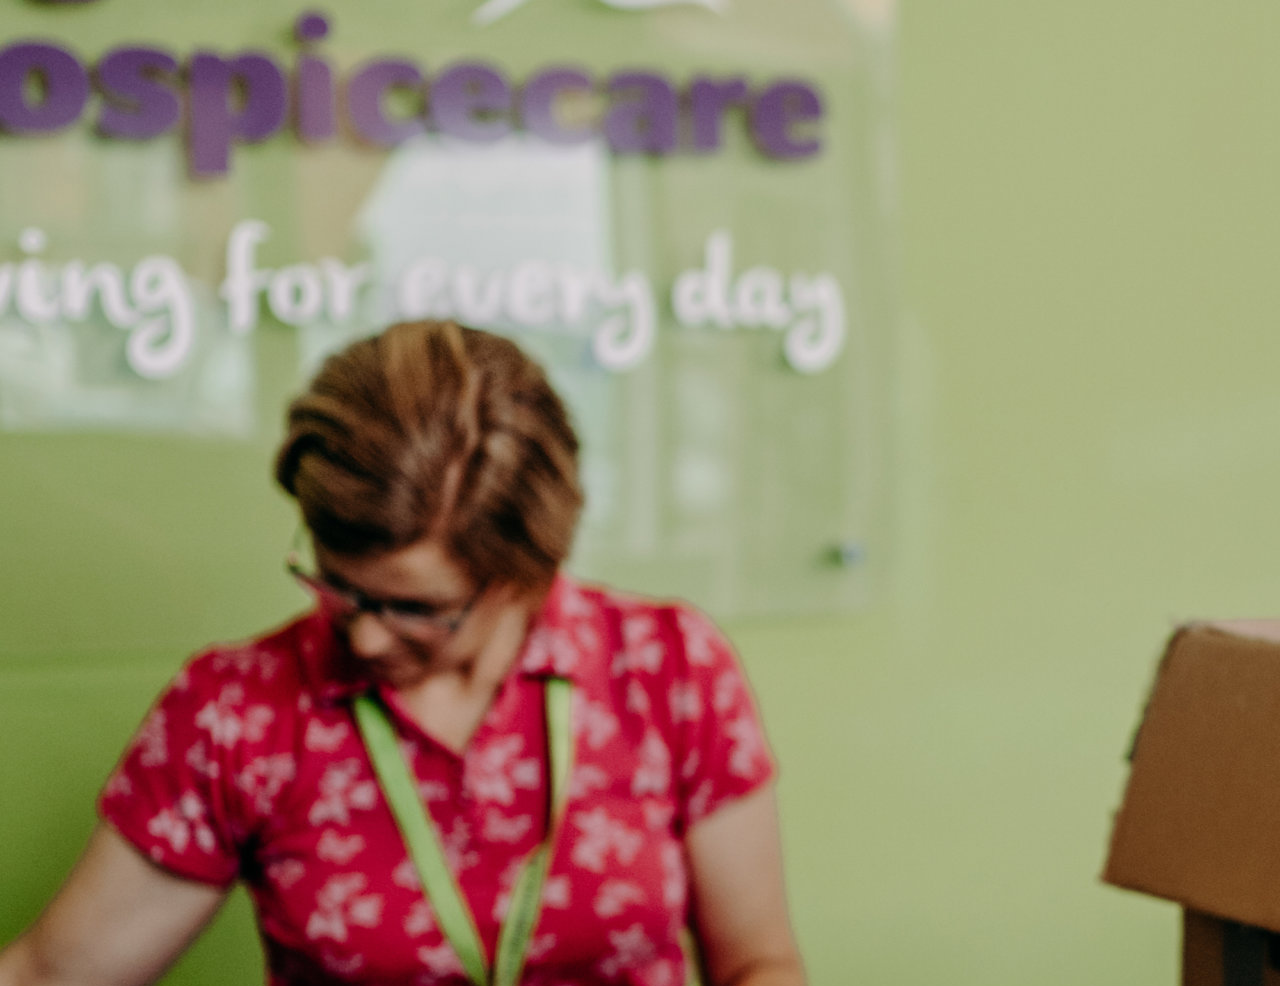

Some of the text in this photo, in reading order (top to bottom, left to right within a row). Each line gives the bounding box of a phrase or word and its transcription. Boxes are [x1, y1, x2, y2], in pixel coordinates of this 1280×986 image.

[0, 220, 846, 378] ing for every day
